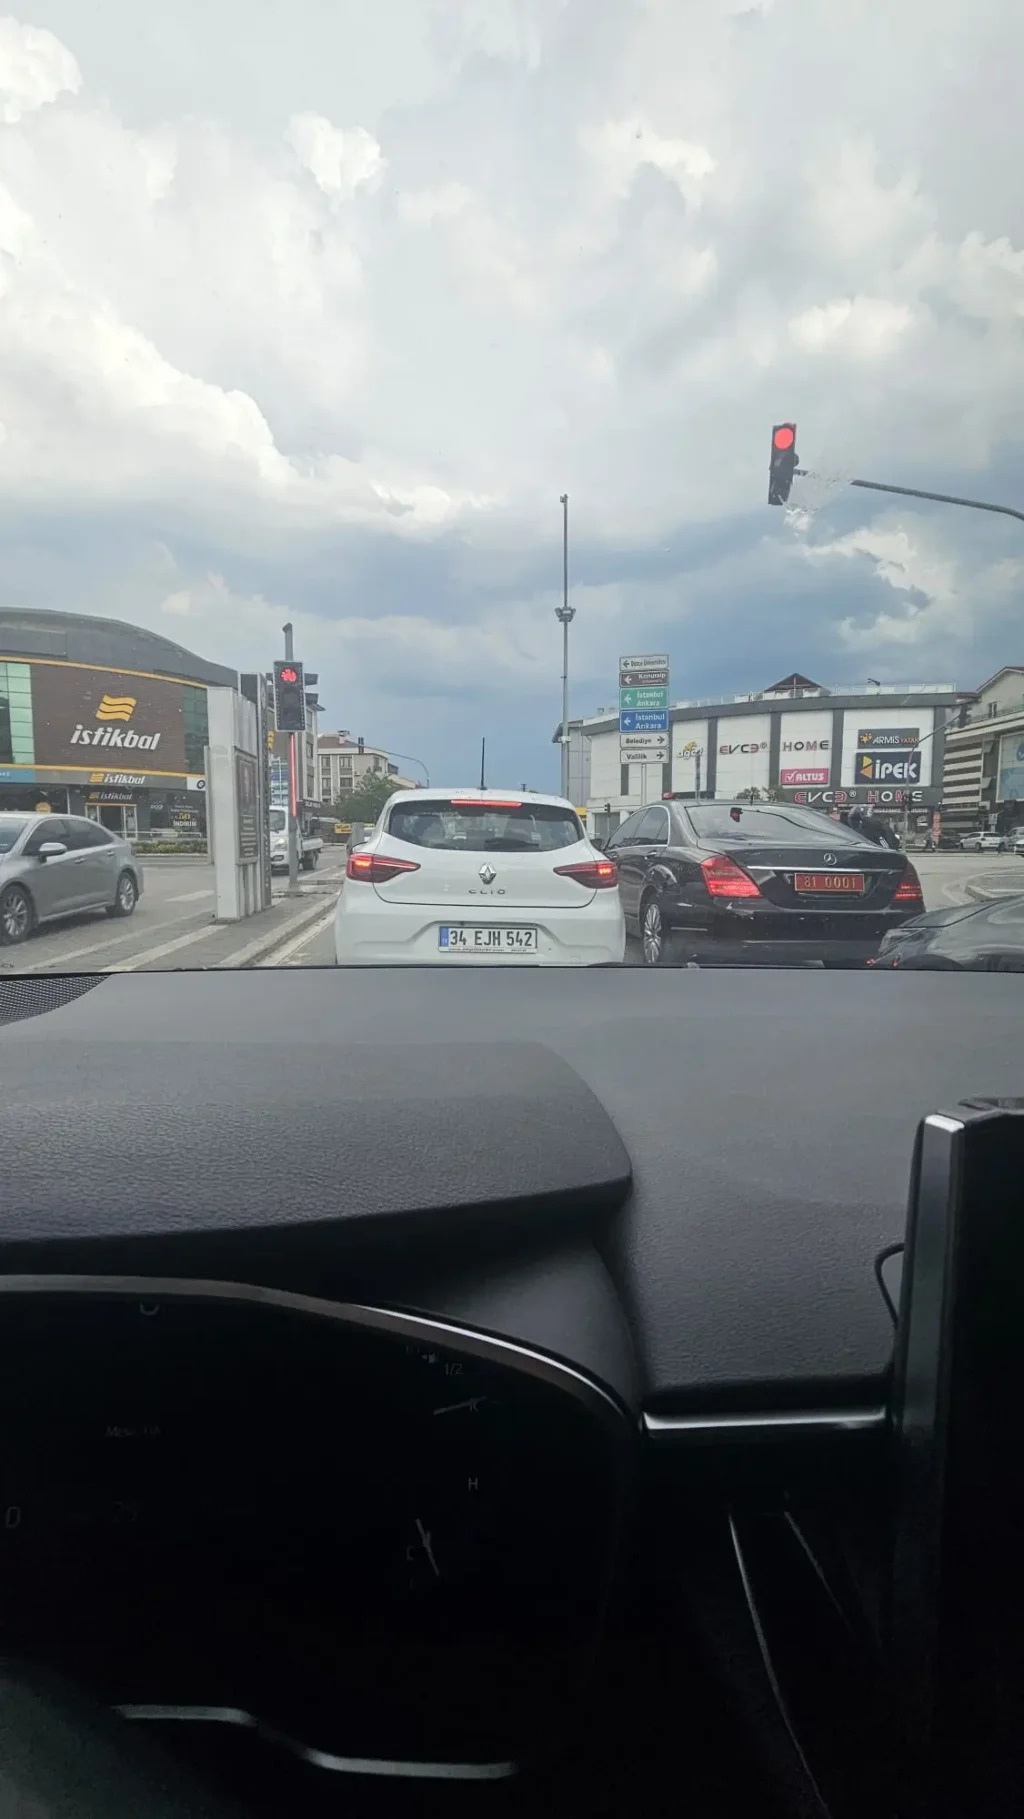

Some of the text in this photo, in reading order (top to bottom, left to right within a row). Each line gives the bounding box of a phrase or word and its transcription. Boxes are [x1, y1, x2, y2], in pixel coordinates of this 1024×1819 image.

[635, 713, 665, 721] İstanbul
[635, 722, 662, 730] Ankara
[70, 724, 161, 750] istikbal
[783, 740, 829, 752] HOME
[103, 773, 146, 785] istikbal
[795, 773, 824, 782] ALTUS
[450, 930, 533, 947] 34 EJH 542
[468, 1476, 479, 1492] H
